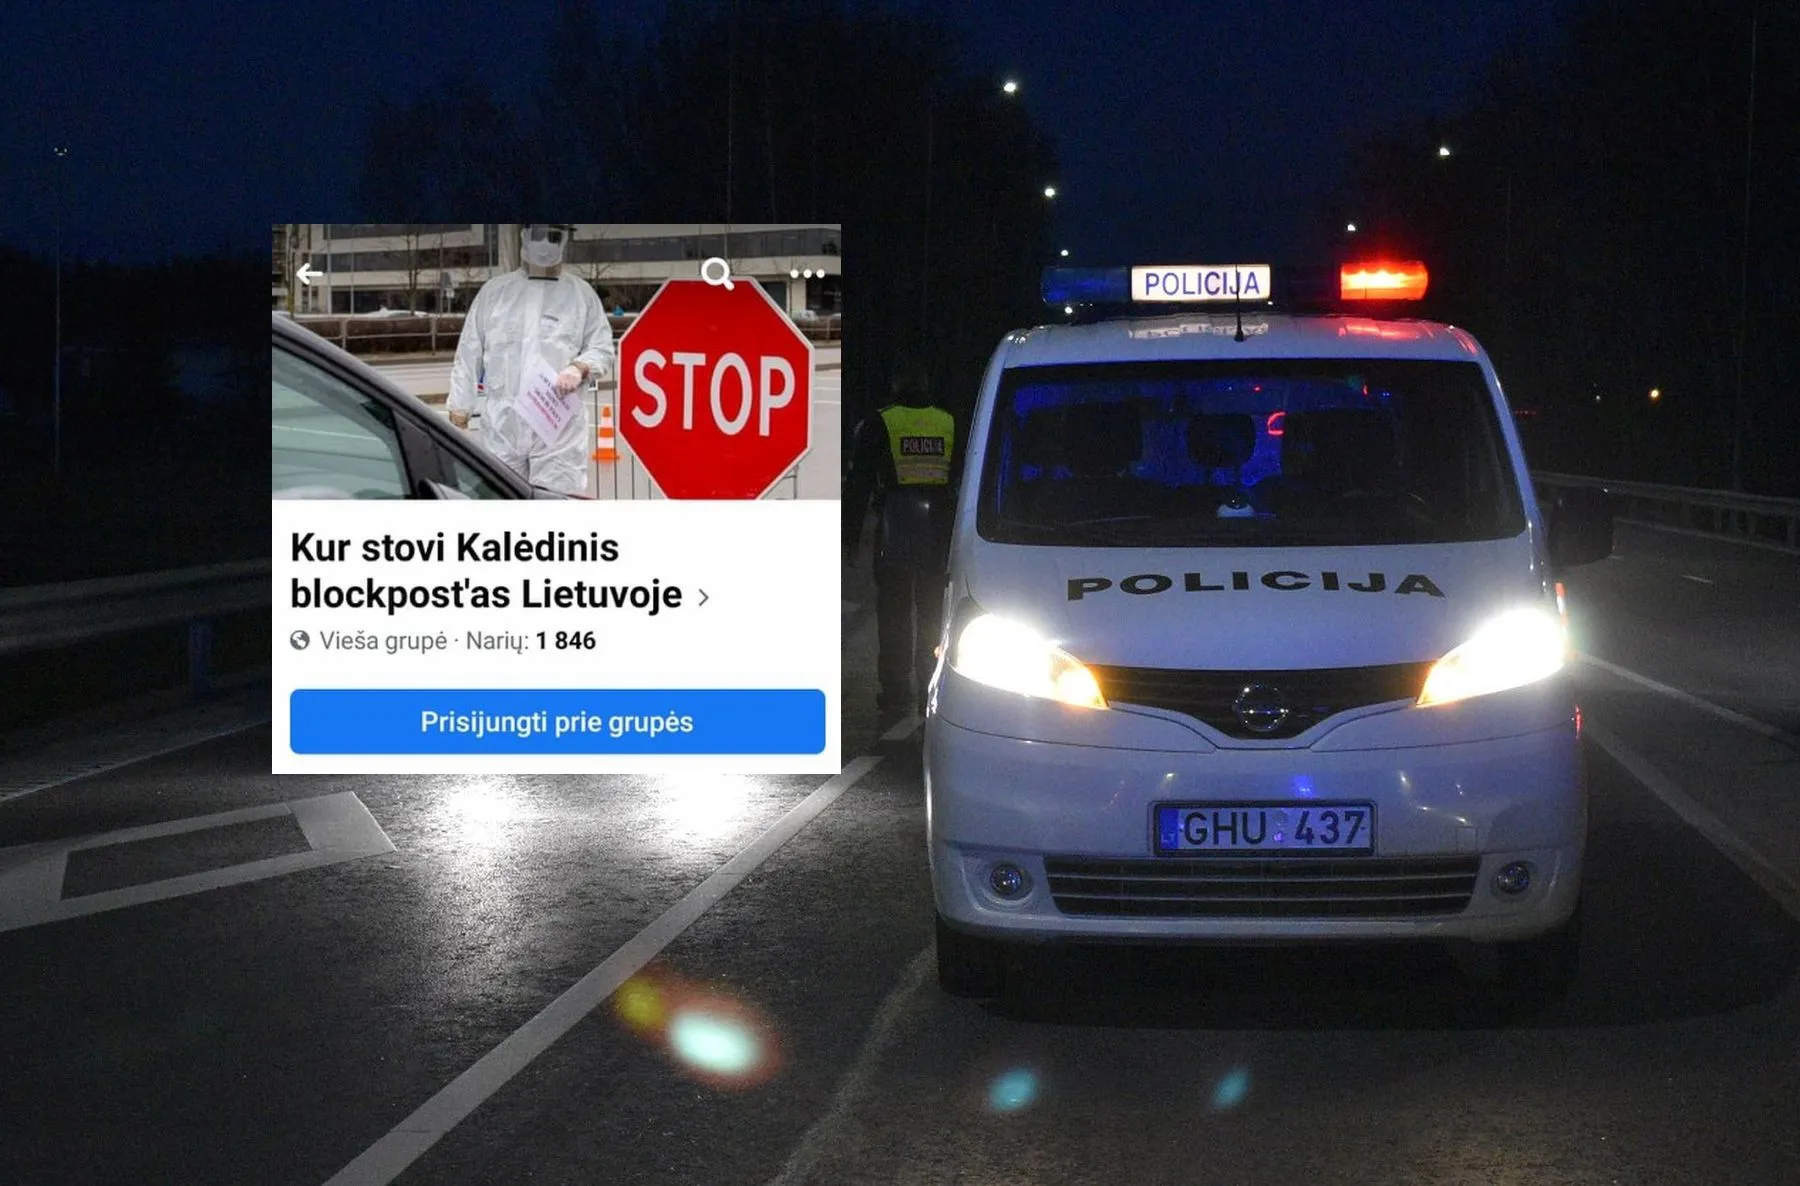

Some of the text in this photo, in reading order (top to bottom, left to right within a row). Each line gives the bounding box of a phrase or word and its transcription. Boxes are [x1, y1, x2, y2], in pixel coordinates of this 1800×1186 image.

[1145, 271, 1260, 296] POLICIJA
[1067, 570, 1446, 600] POLICIJA
[1184, 810, 1365, 845] GHU 437
